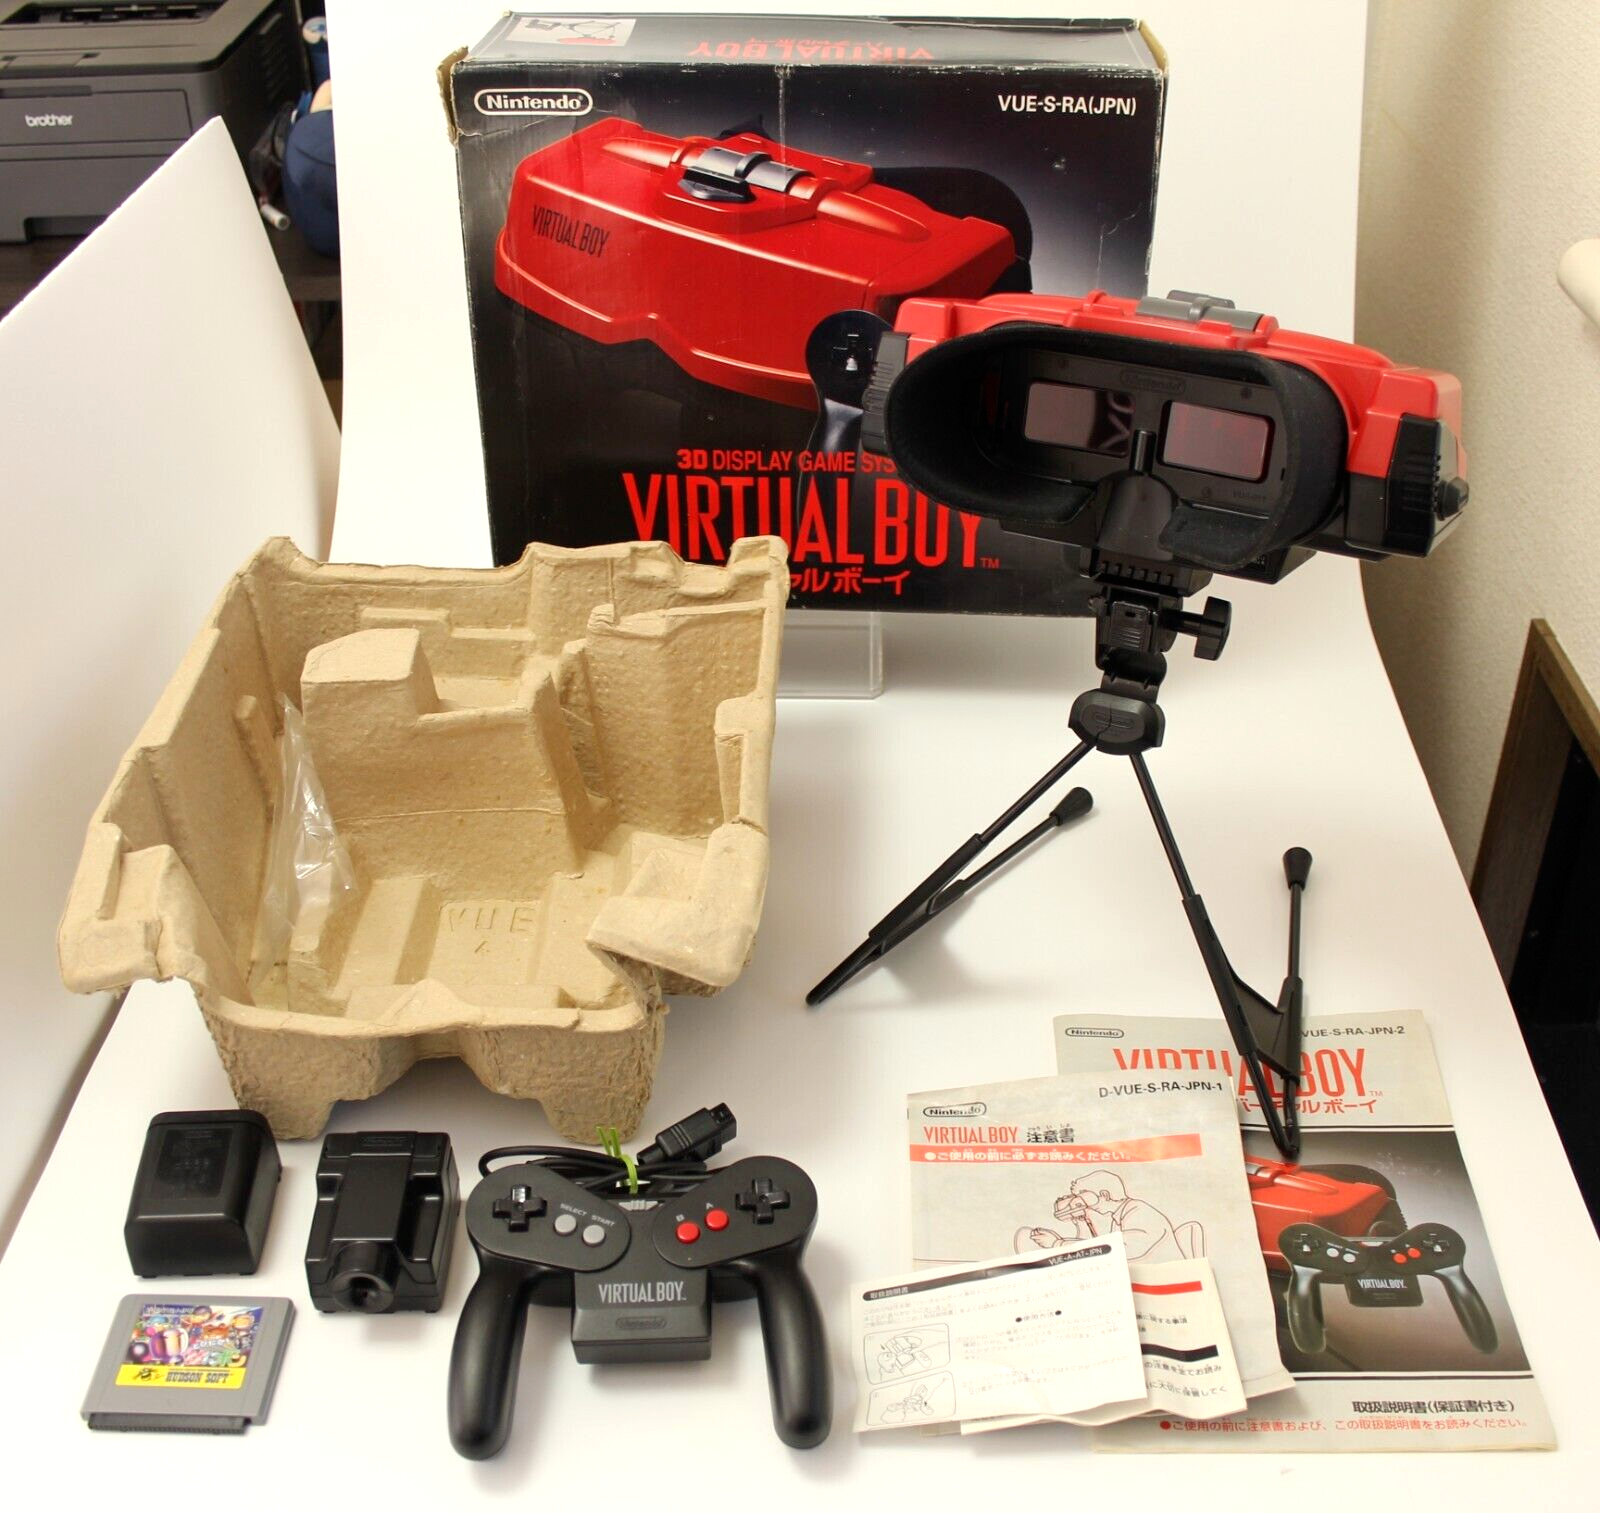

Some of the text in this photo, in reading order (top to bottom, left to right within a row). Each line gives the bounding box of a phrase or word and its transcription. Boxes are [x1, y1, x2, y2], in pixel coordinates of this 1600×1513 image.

[485, 94, 583, 110] Nintendo
[997, 94, 1137, 116] VUE-S-RA(JPN)
[24, 113, 74, 128] brother
[532, 204, 611, 258] VIRTUAL BOY
[677, 448, 897, 473] 3D DISPLAY GAME SYS
[622, 472, 1001, 569] VIRTUAL BOY TM
[1070, 1028, 1120, 1037] Nintendo
[1098, 1081, 1224, 1099] D-VUE-S-RA-JPN-1
[923, 1126, 987, 1144] VIRTUAL
[988, 1126, 1019, 1144] BOY
[559, 1203, 616, 1227] SELECT START
[599, 1281, 685, 1304] VIRTUAL BOY
[165, 1371, 229, 1384] HUDSON SOFT
